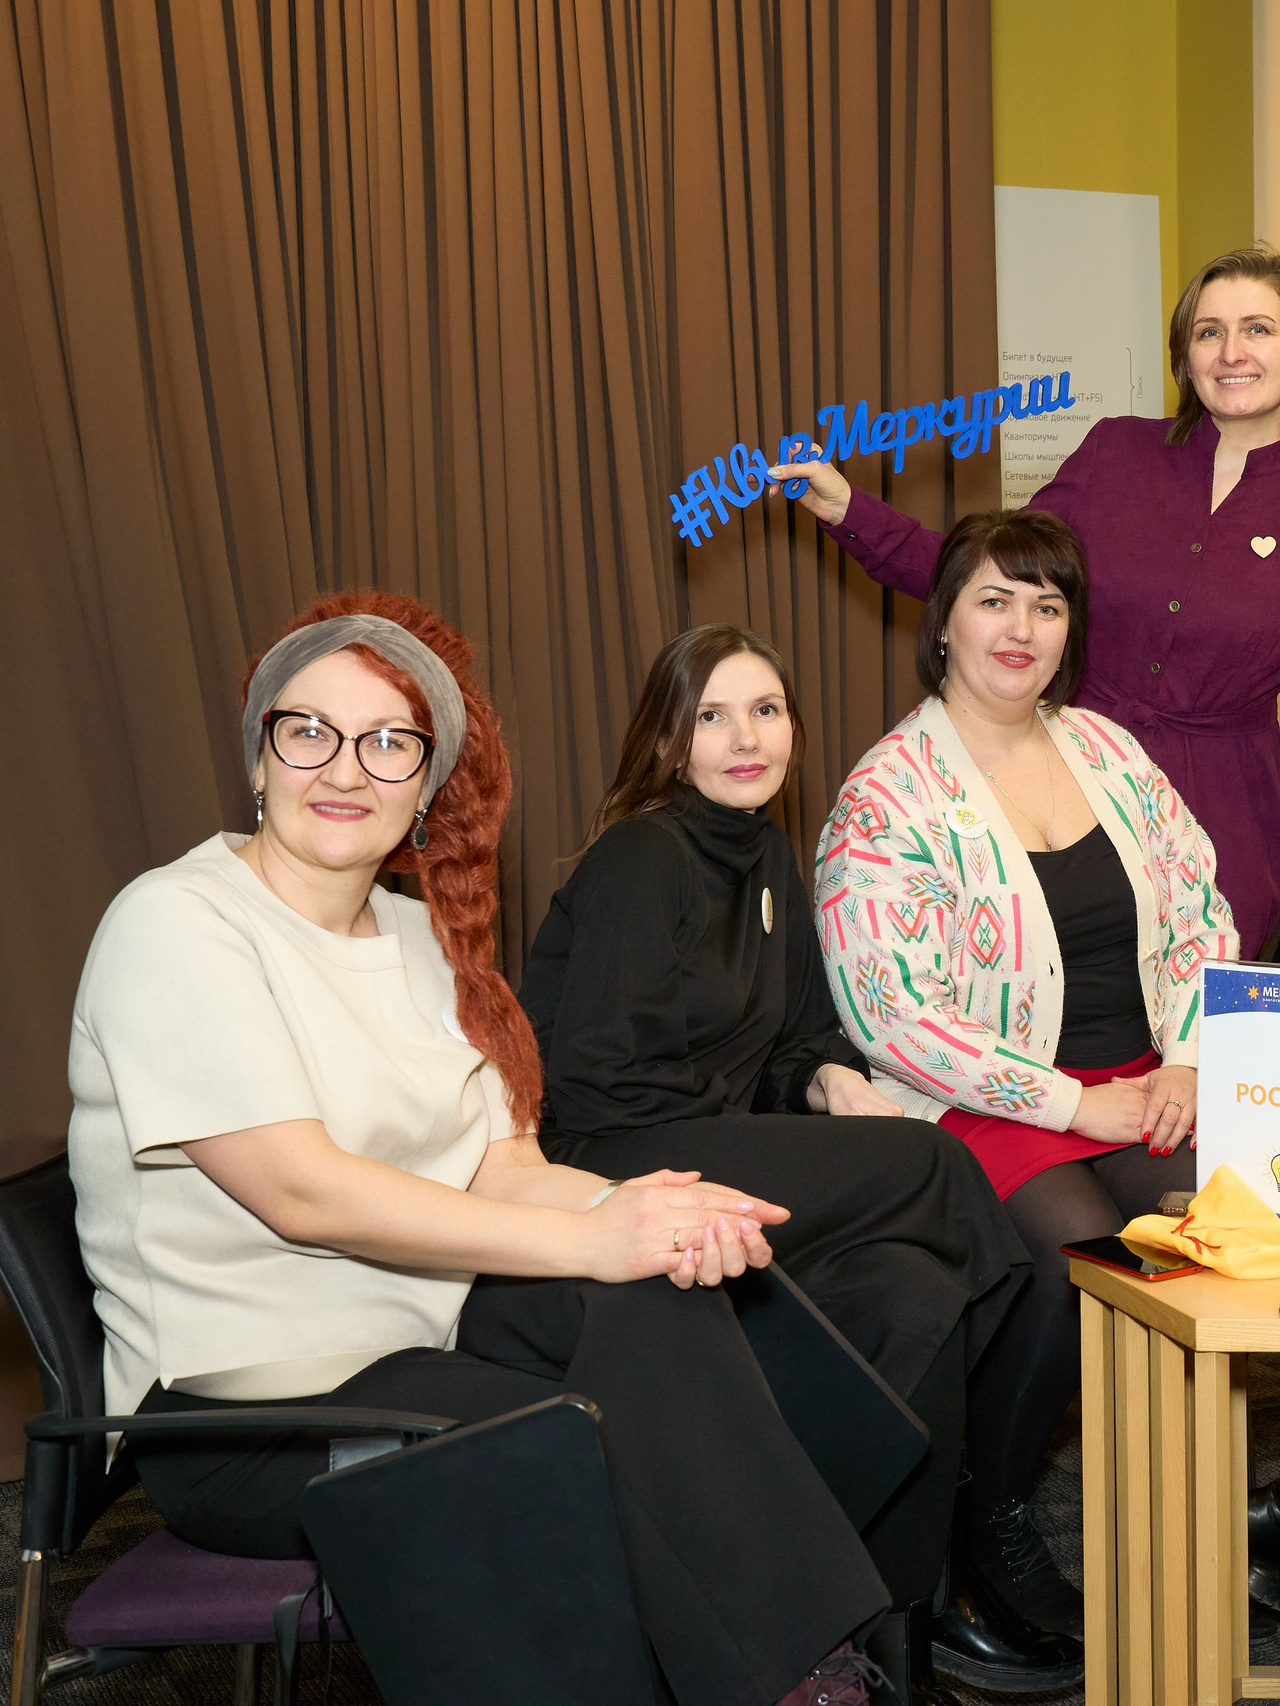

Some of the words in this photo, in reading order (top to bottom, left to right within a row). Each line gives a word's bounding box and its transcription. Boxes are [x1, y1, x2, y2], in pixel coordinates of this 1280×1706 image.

[1002, 352, 1027, 362] Билет
[1036, 353, 1073, 364] будущее
[1002, 371, 1047, 381] Олимпиа
[1136, 376, 1144, 399] Поиск
[1050, 413, 1091, 422] движение
[1004, 432, 1059, 442] Кванториумы
[1004, 452, 1034, 461] Школы
[1004, 471, 1039, 480] Сетевые
